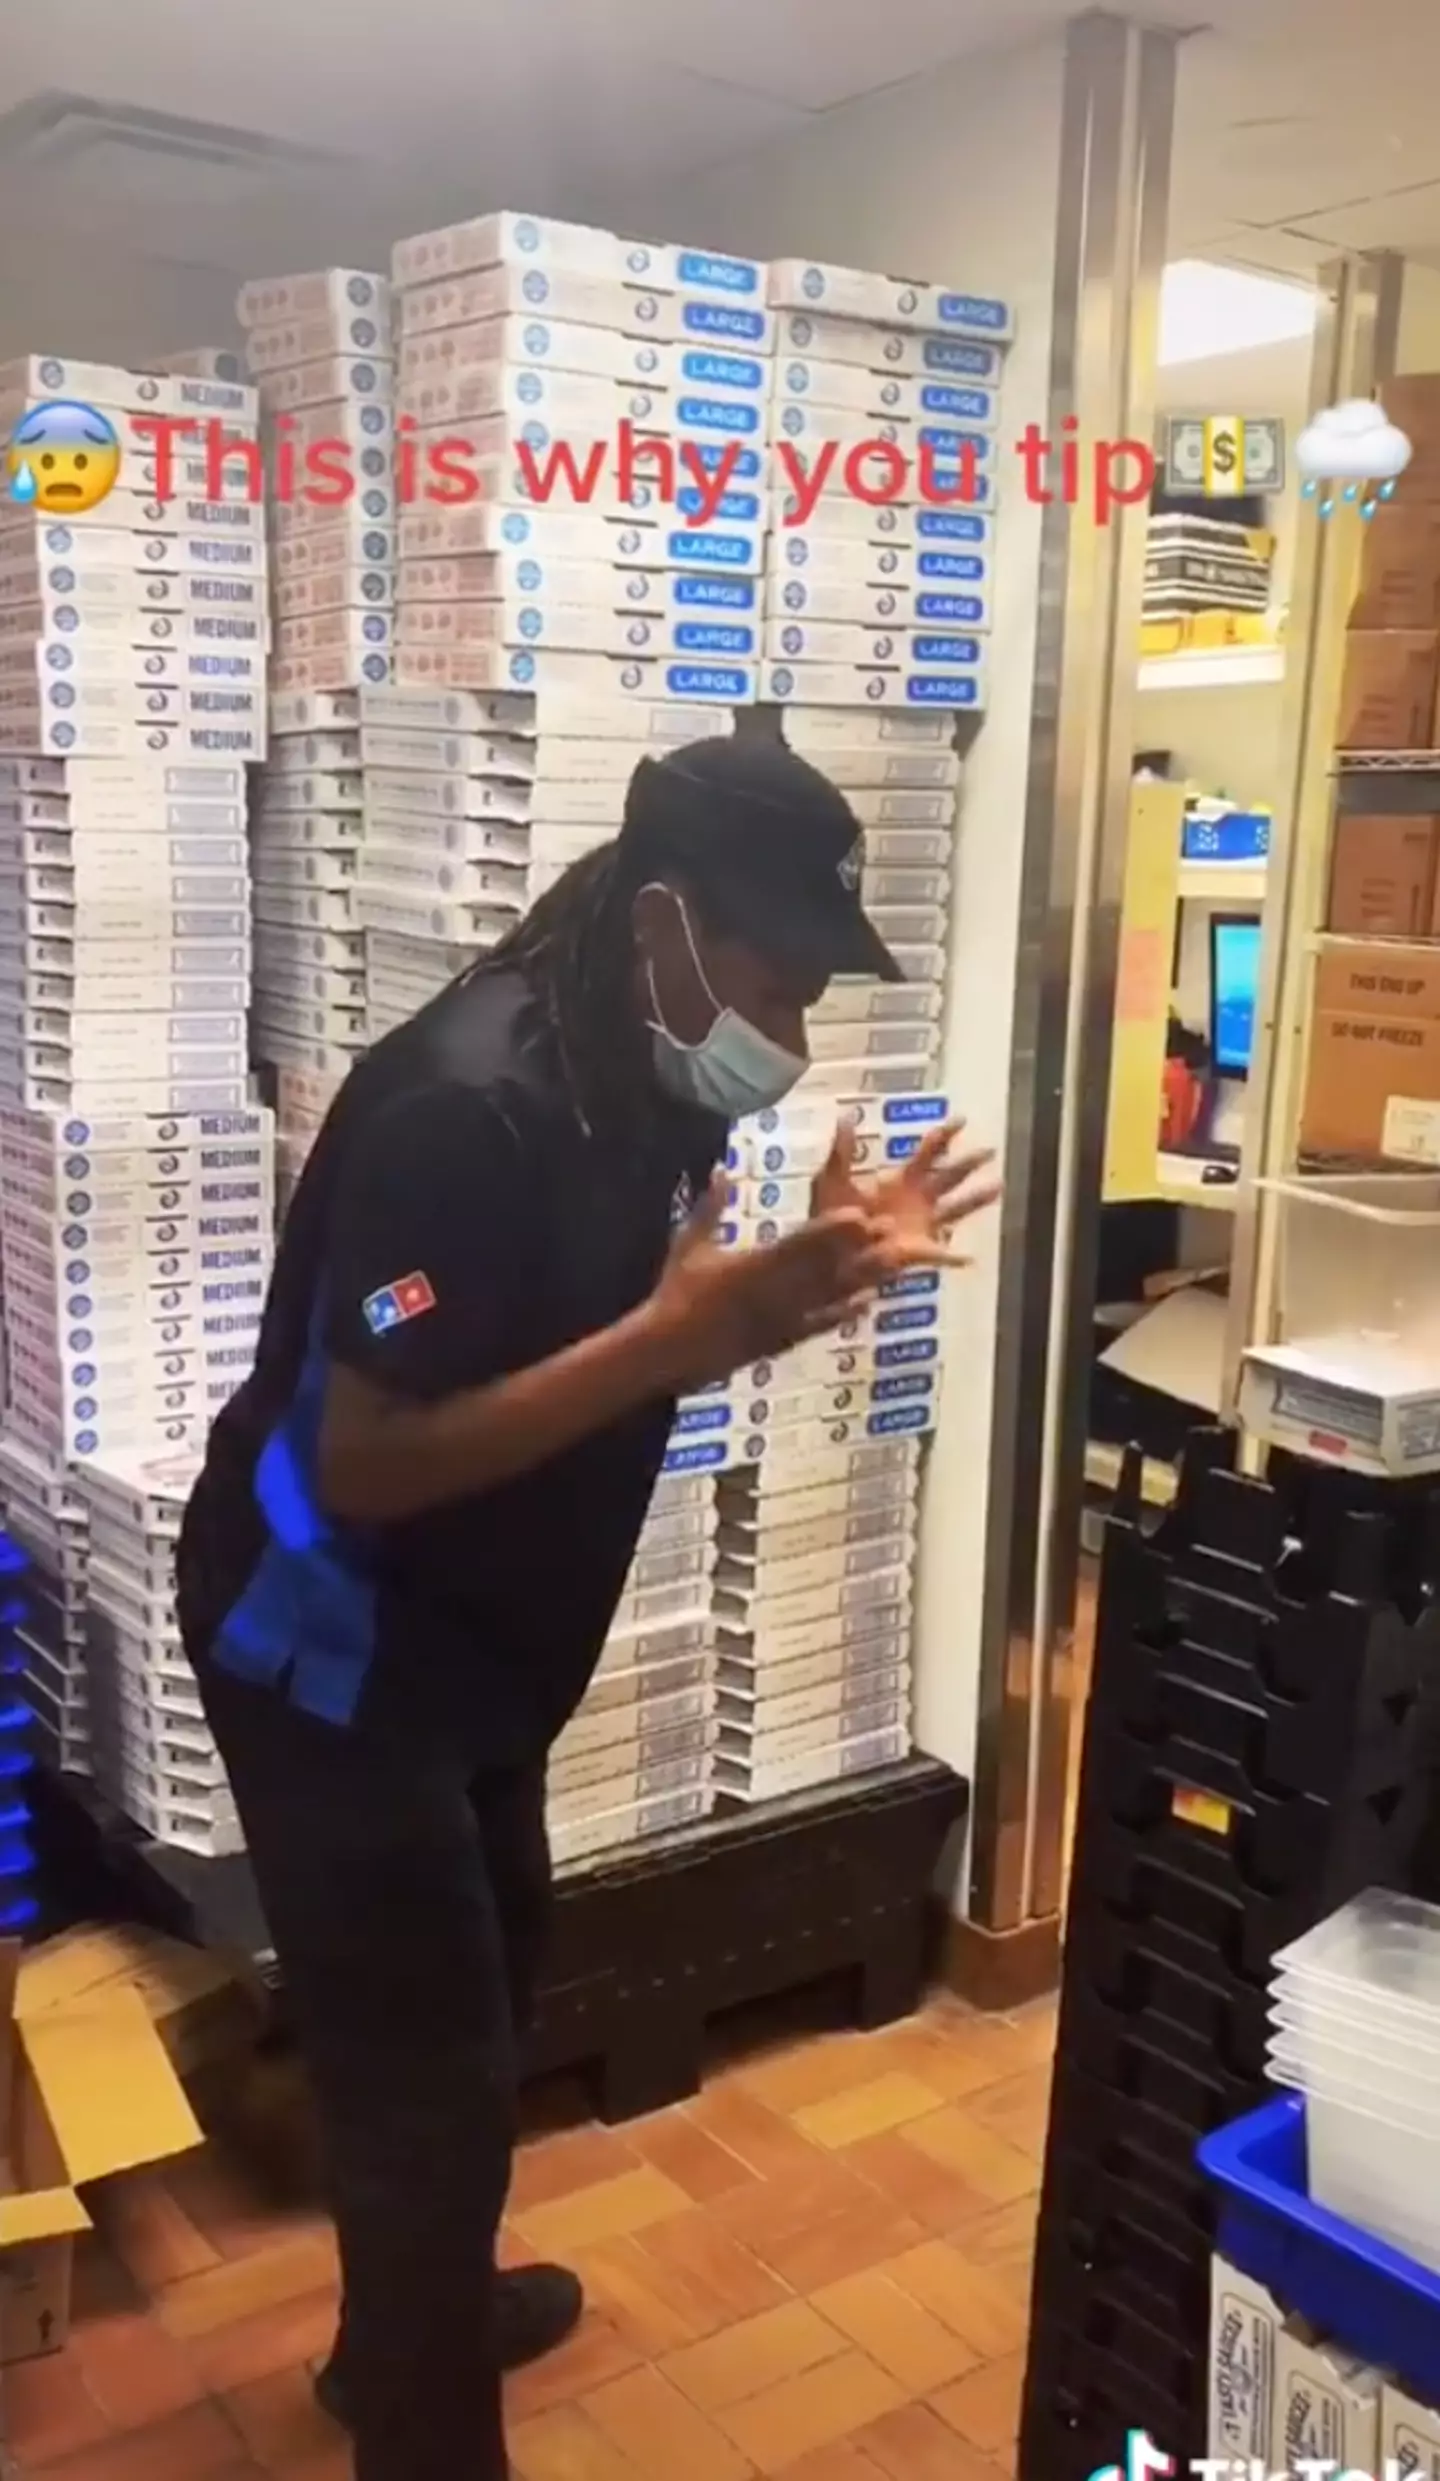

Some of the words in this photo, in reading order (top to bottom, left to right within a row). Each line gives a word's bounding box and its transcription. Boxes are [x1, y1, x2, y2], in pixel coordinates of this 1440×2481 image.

[685, 260, 747, 284] LARGE
[692, 308, 756, 333] LARGE
[692, 360, 754, 385] LARGE
[684, 405, 748, 428] LARGE
[676, 539, 744, 559] LARGE
[681, 582, 744, 604] LARGE
[682, 629, 744, 650] LARGE
[676, 672, 738, 692] LARGE
